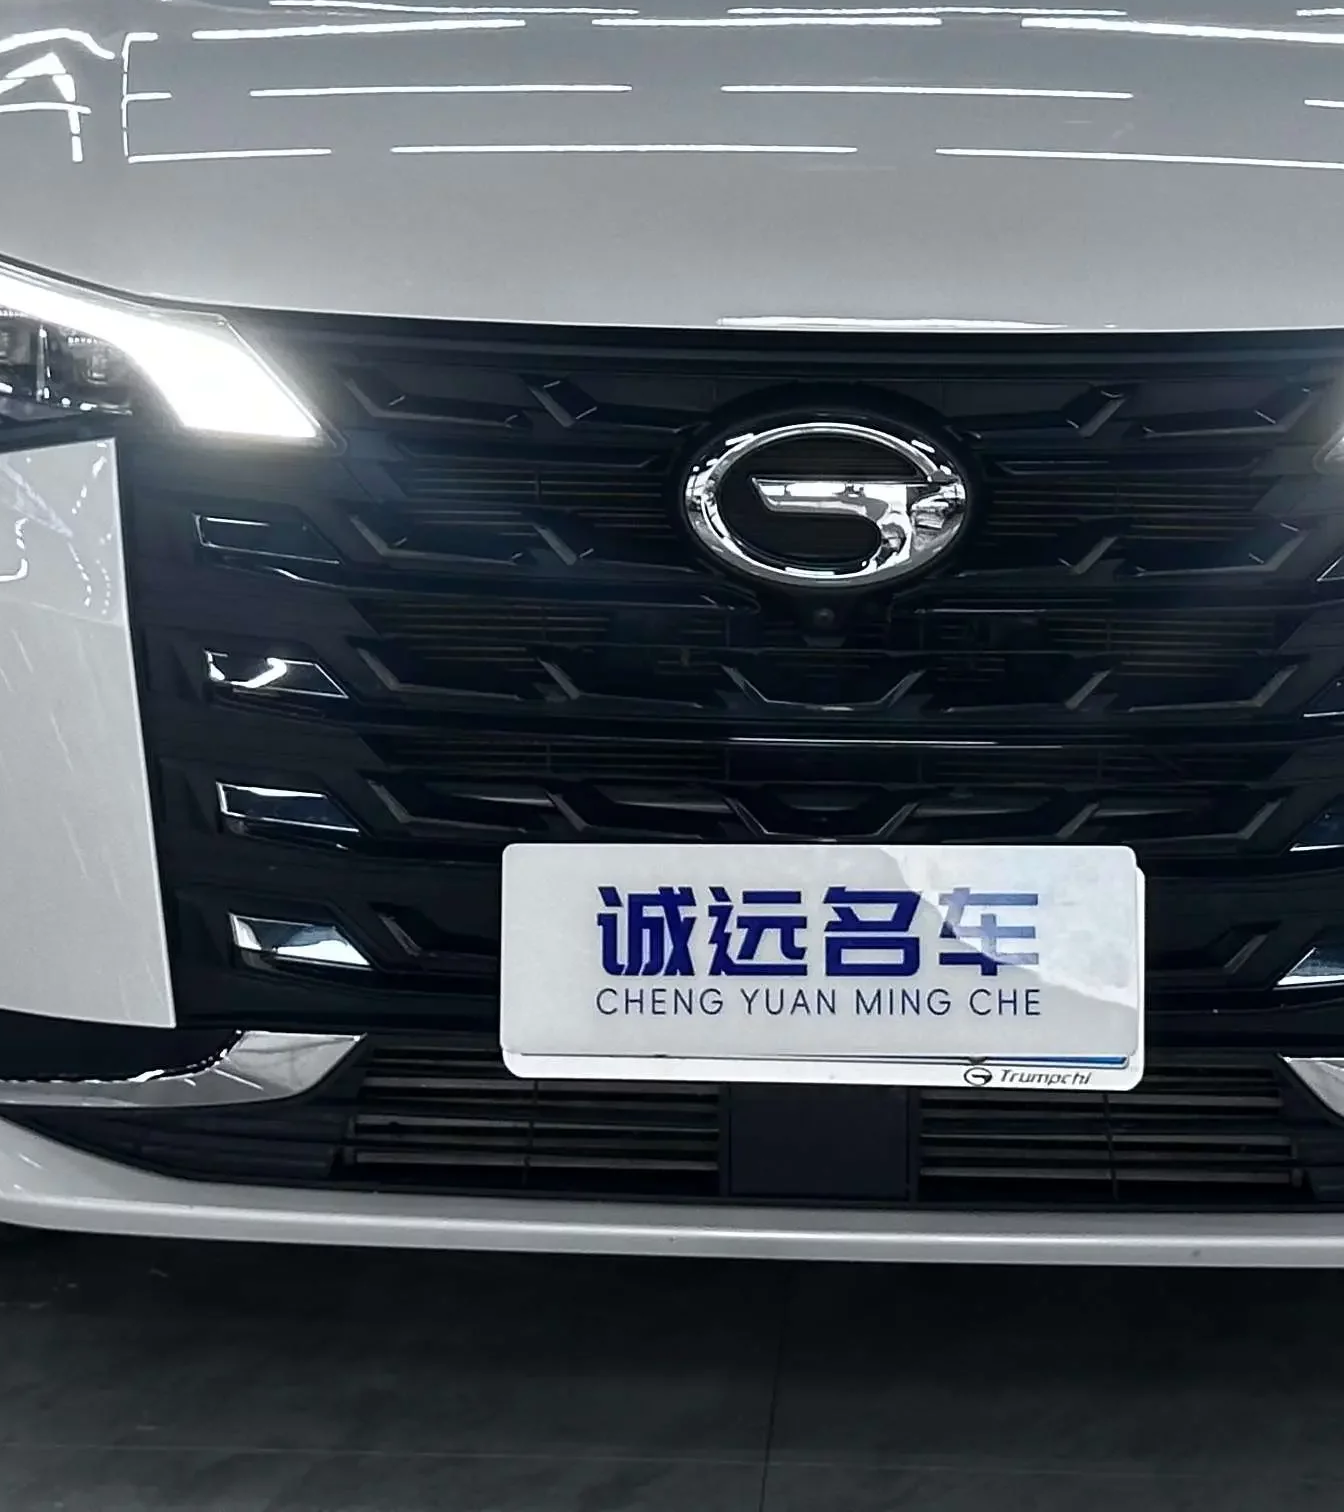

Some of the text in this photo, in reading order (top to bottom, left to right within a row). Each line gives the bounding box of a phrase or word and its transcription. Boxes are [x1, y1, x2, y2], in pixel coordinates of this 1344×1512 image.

[596, 886, 1040, 978] 诚远名车
[596, 987, 1042, 1017] CHENG YUAN MING CHE
[999, 1068, 1092, 1086] Trumpchi
